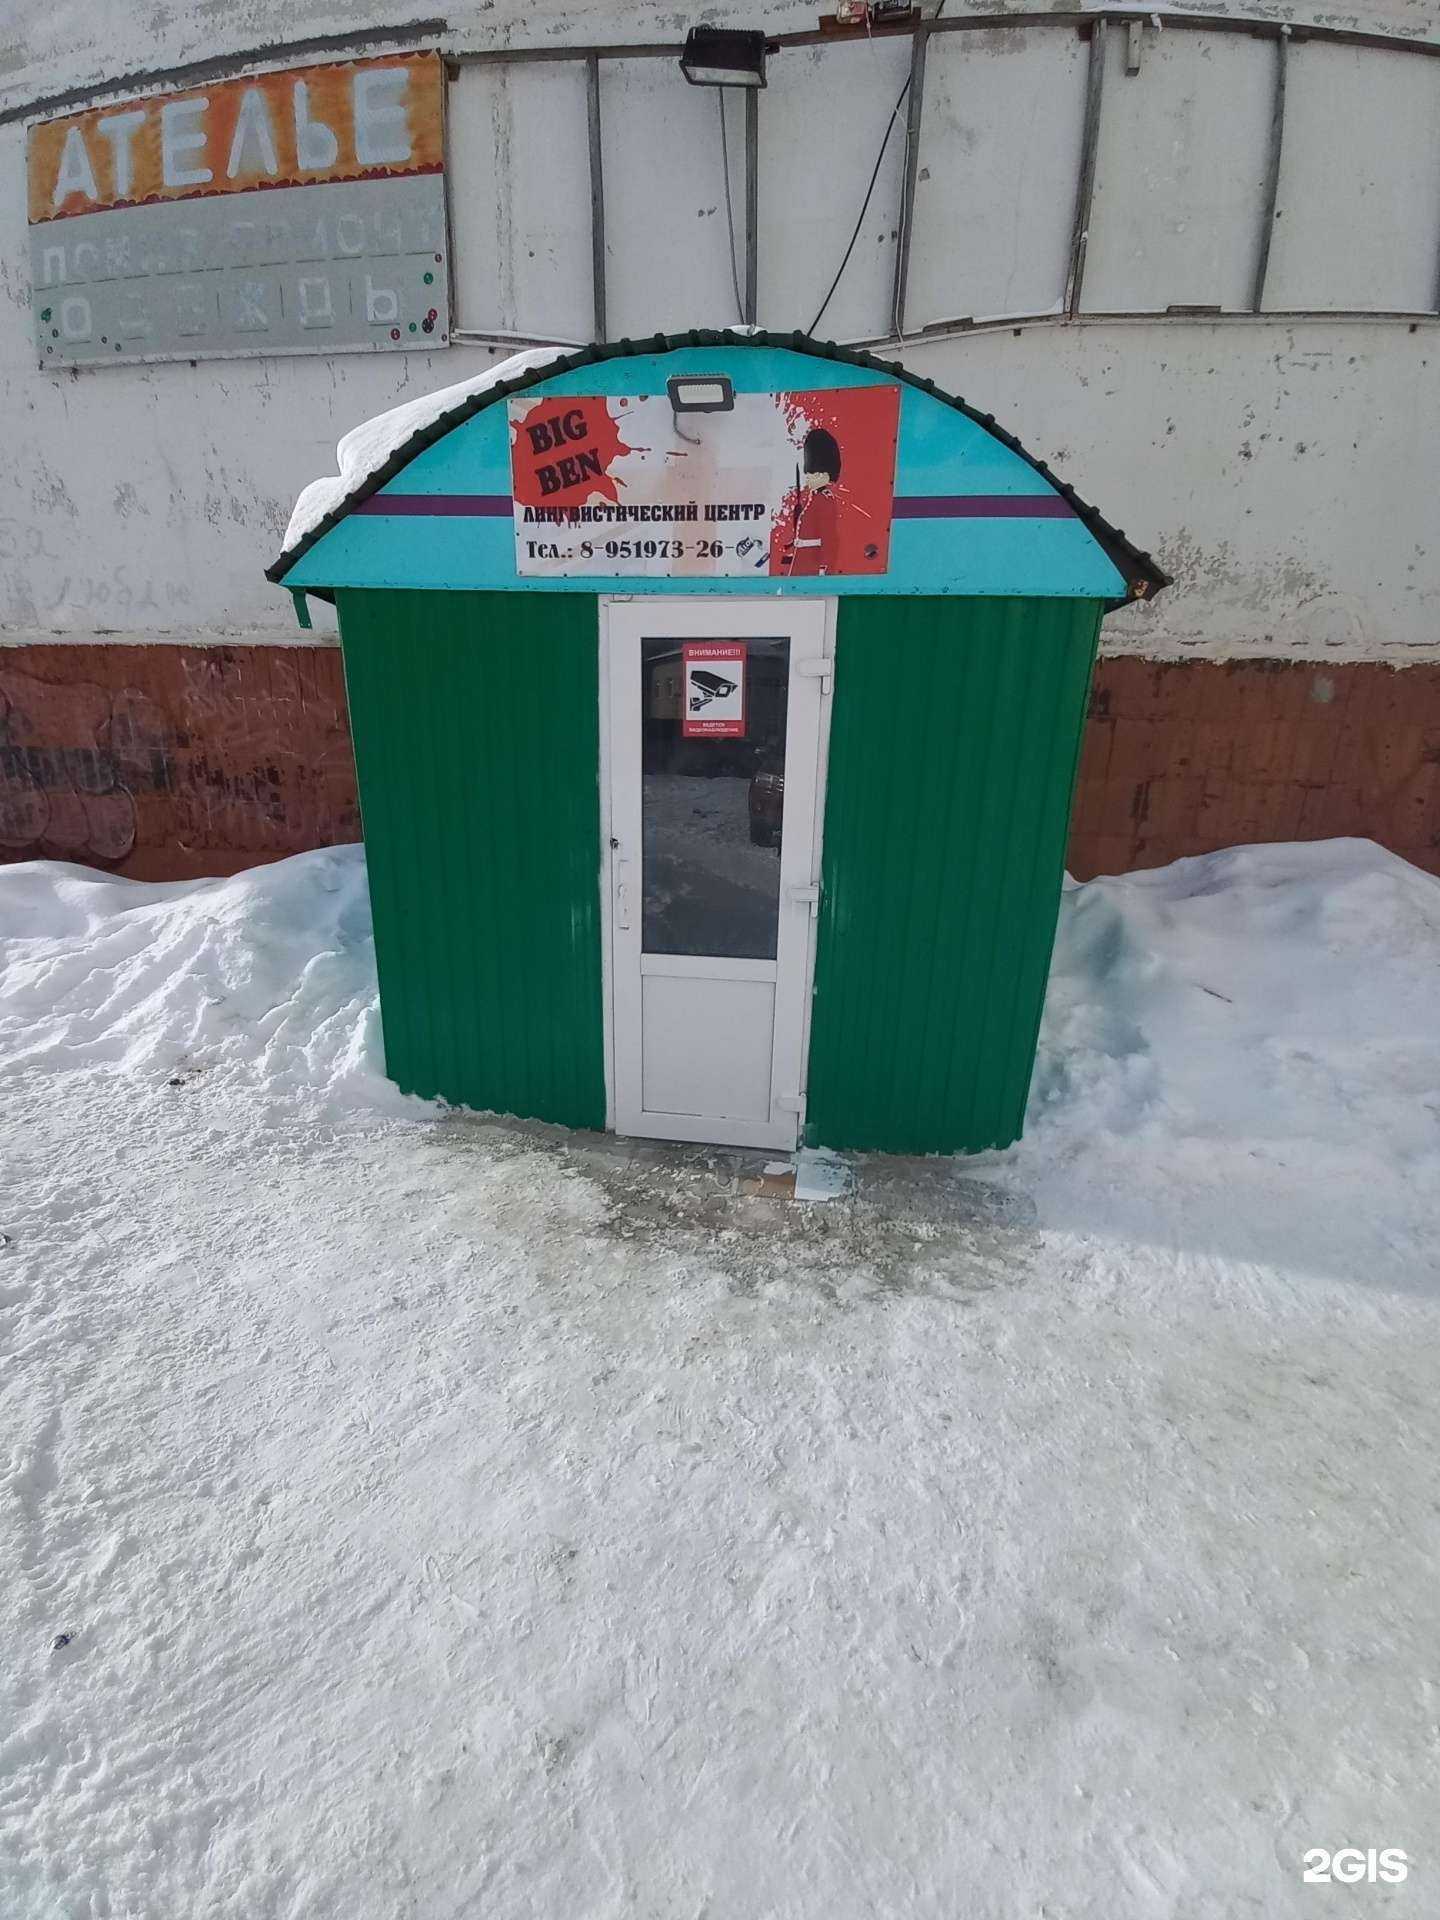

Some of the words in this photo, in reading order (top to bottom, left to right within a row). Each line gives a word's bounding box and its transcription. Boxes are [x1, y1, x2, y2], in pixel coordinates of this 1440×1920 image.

[53, 67, 412, 207] АТЕЛЬЕ
[526, 409, 588, 455] BIG
[534, 448, 603, 496] BEN
[523, 500, 698, 523] ЛИНГВИСТИЧЕСКИЙ
[704, 504, 766, 522] ЦЕНТР
[526, 541, 573, 559] Тел.:
